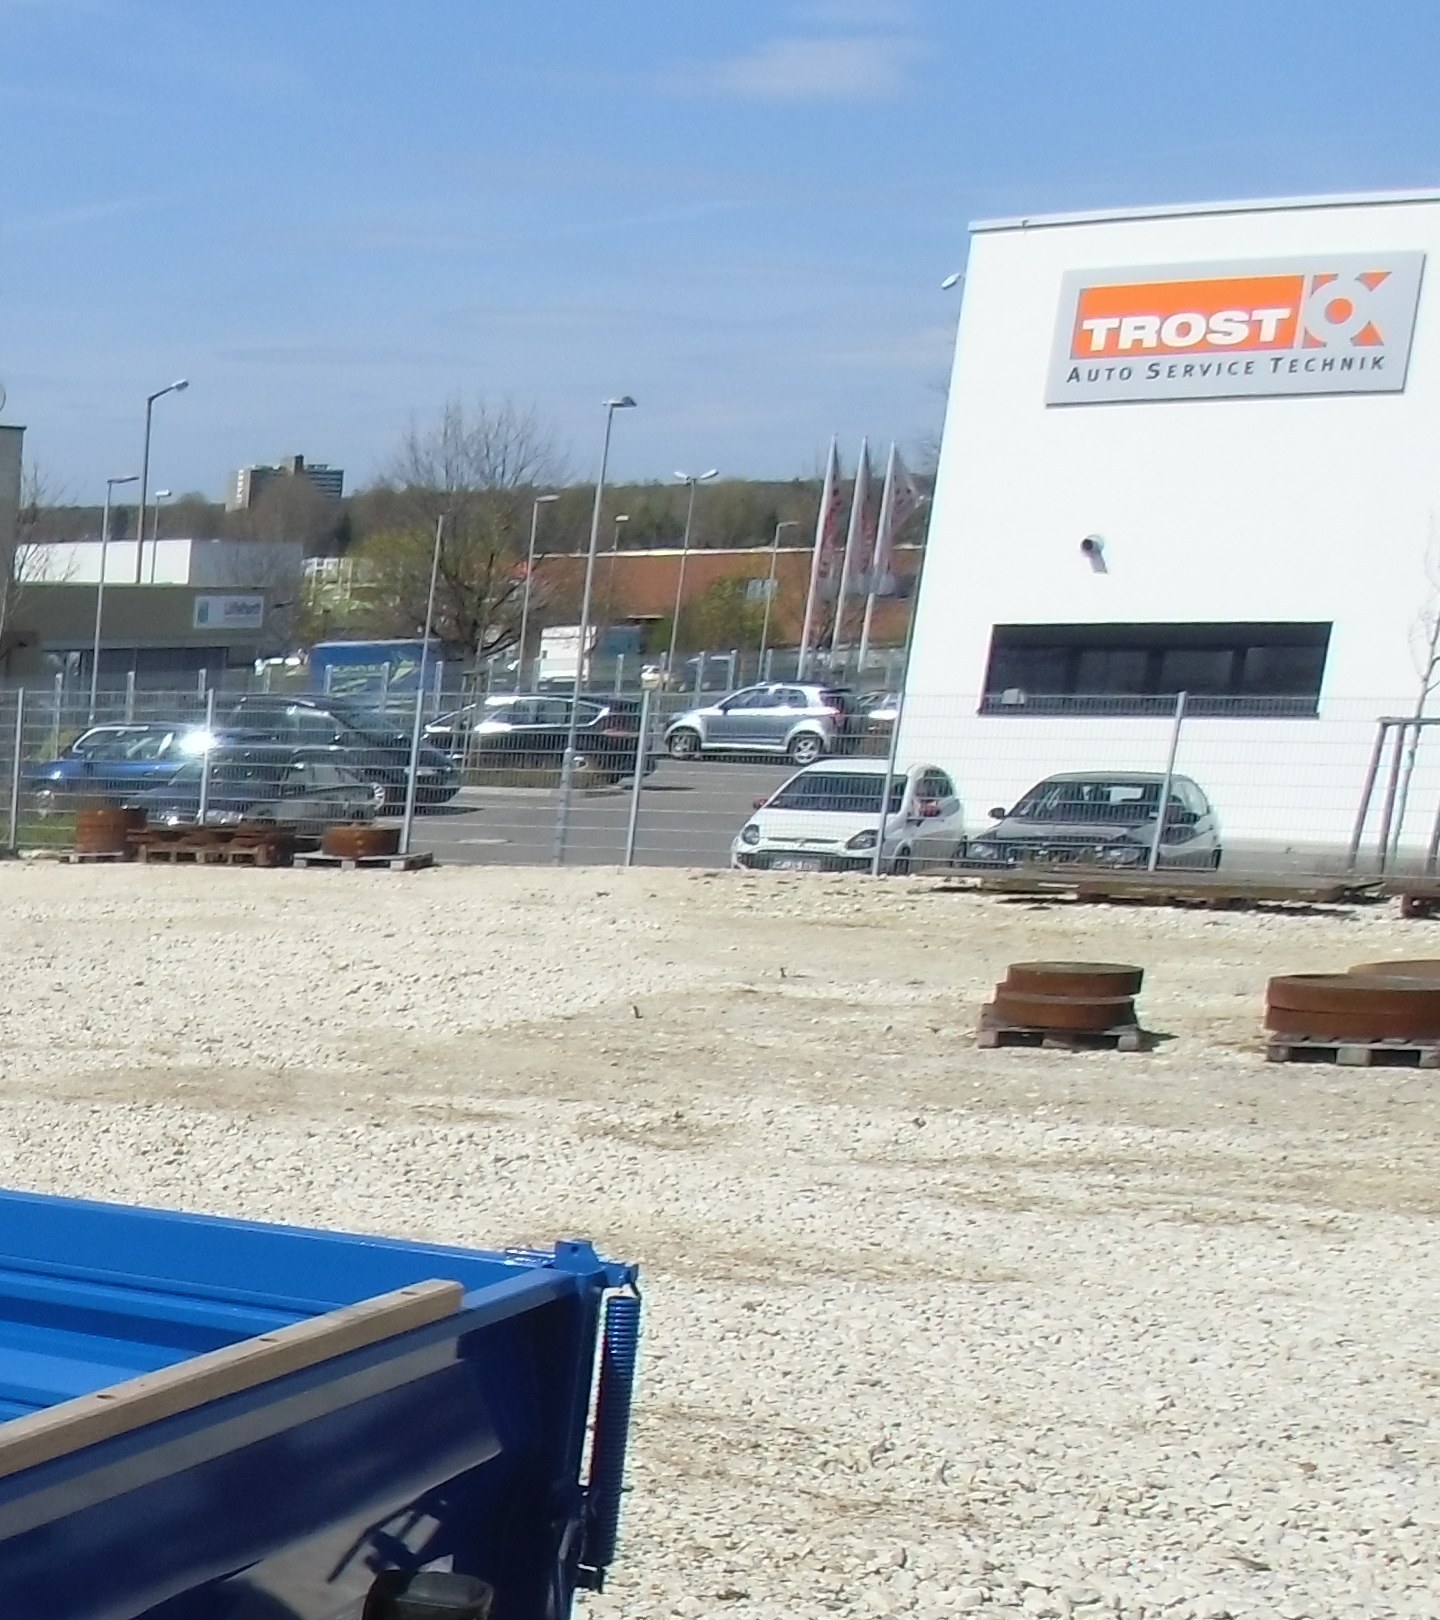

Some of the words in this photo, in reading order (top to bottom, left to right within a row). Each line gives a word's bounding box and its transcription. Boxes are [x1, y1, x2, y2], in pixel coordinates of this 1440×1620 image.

[1081, 307, 1291, 352] TROST
[1066, 365, 1133, 384] AUTO
[1145, 360, 1257, 381] SERVICE
[1270, 354, 1386, 376] TECHNIK
